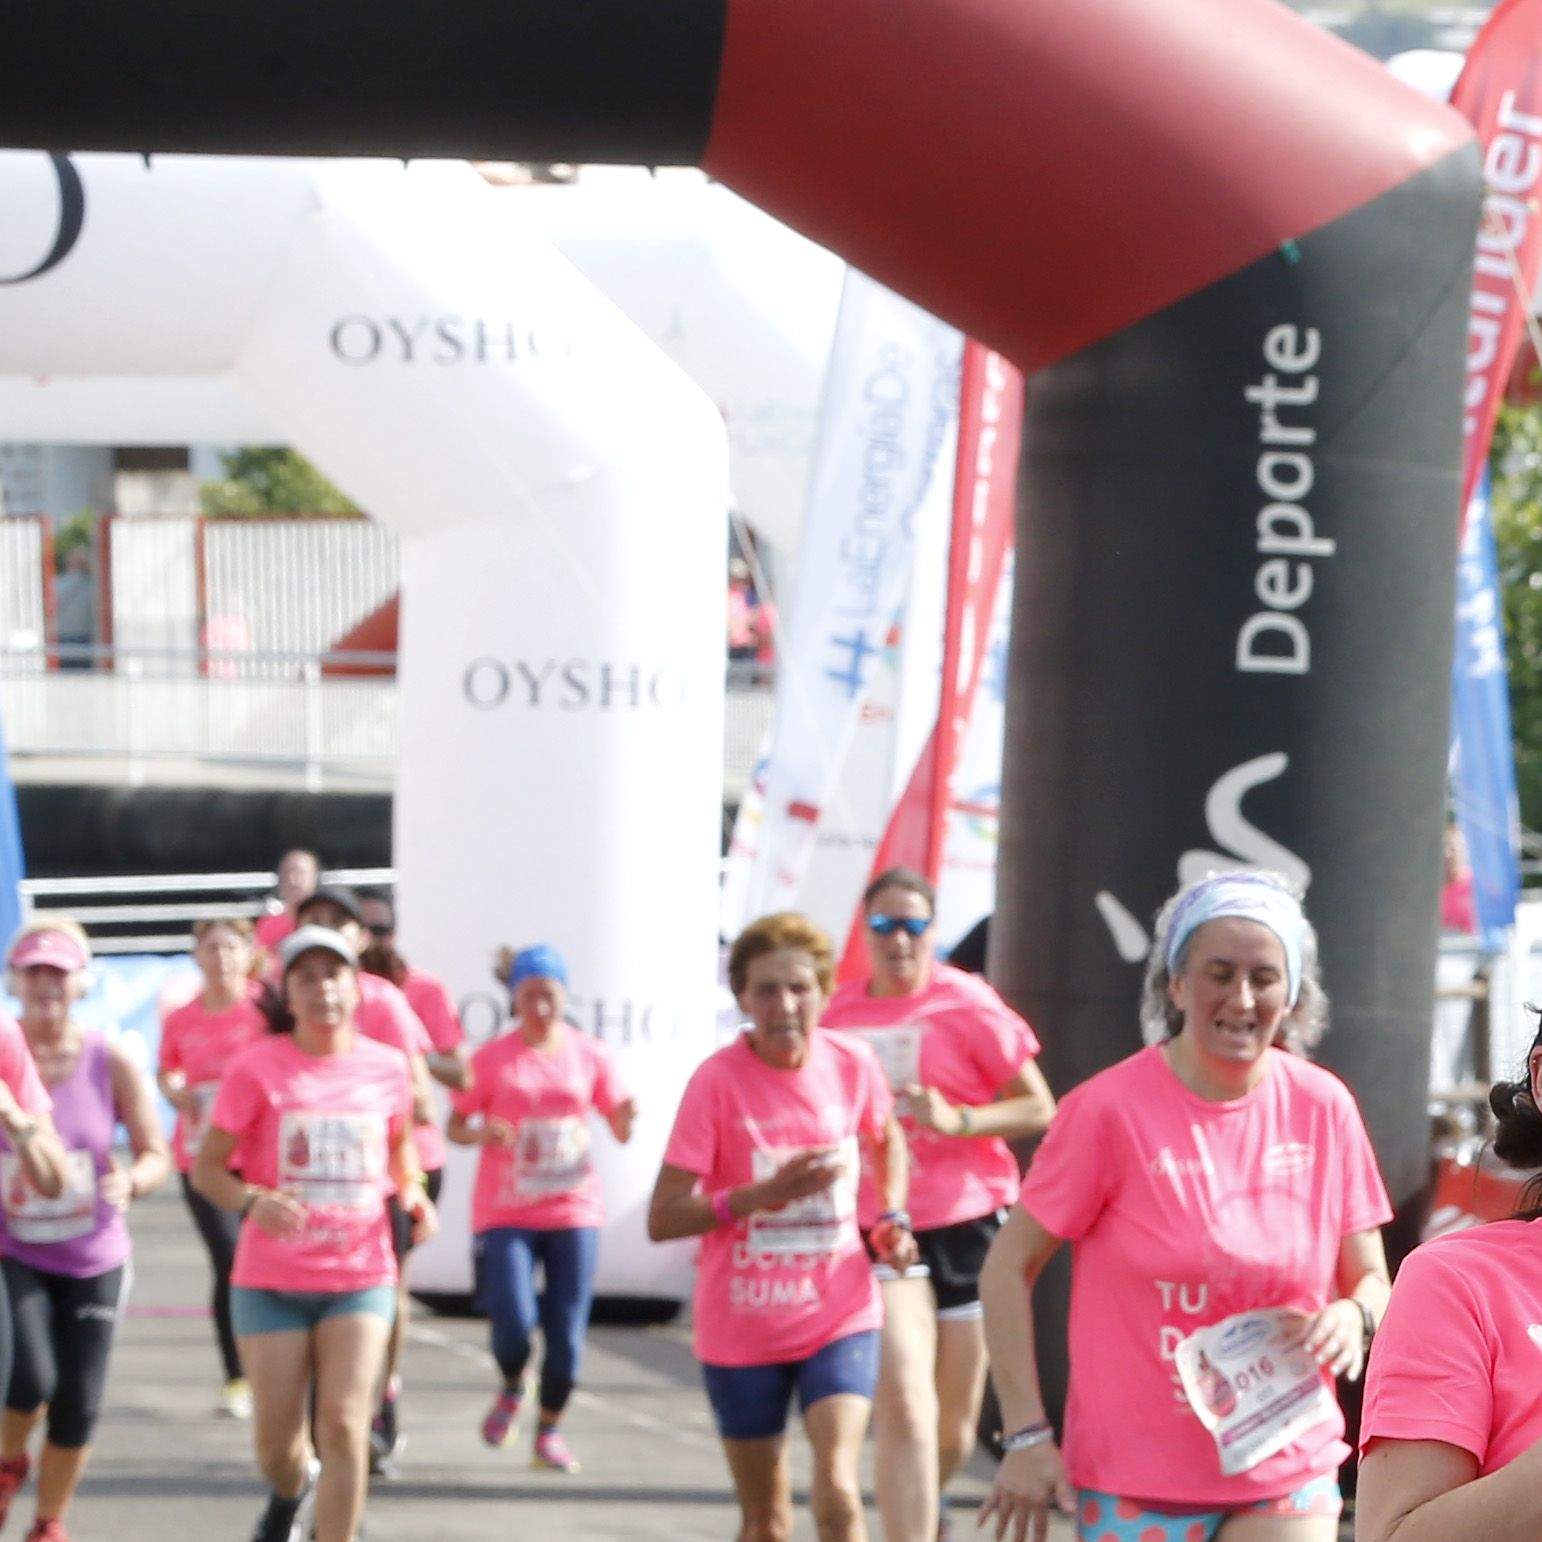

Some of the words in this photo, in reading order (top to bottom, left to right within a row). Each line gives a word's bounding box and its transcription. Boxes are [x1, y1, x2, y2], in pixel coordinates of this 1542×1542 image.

[329, 313, 572, 367] OYSHO
[1236, 323, 1337, 674] Deporte
[462, 655, 690, 711] OYSHO
[1154, 1279, 1208, 1315] TU
